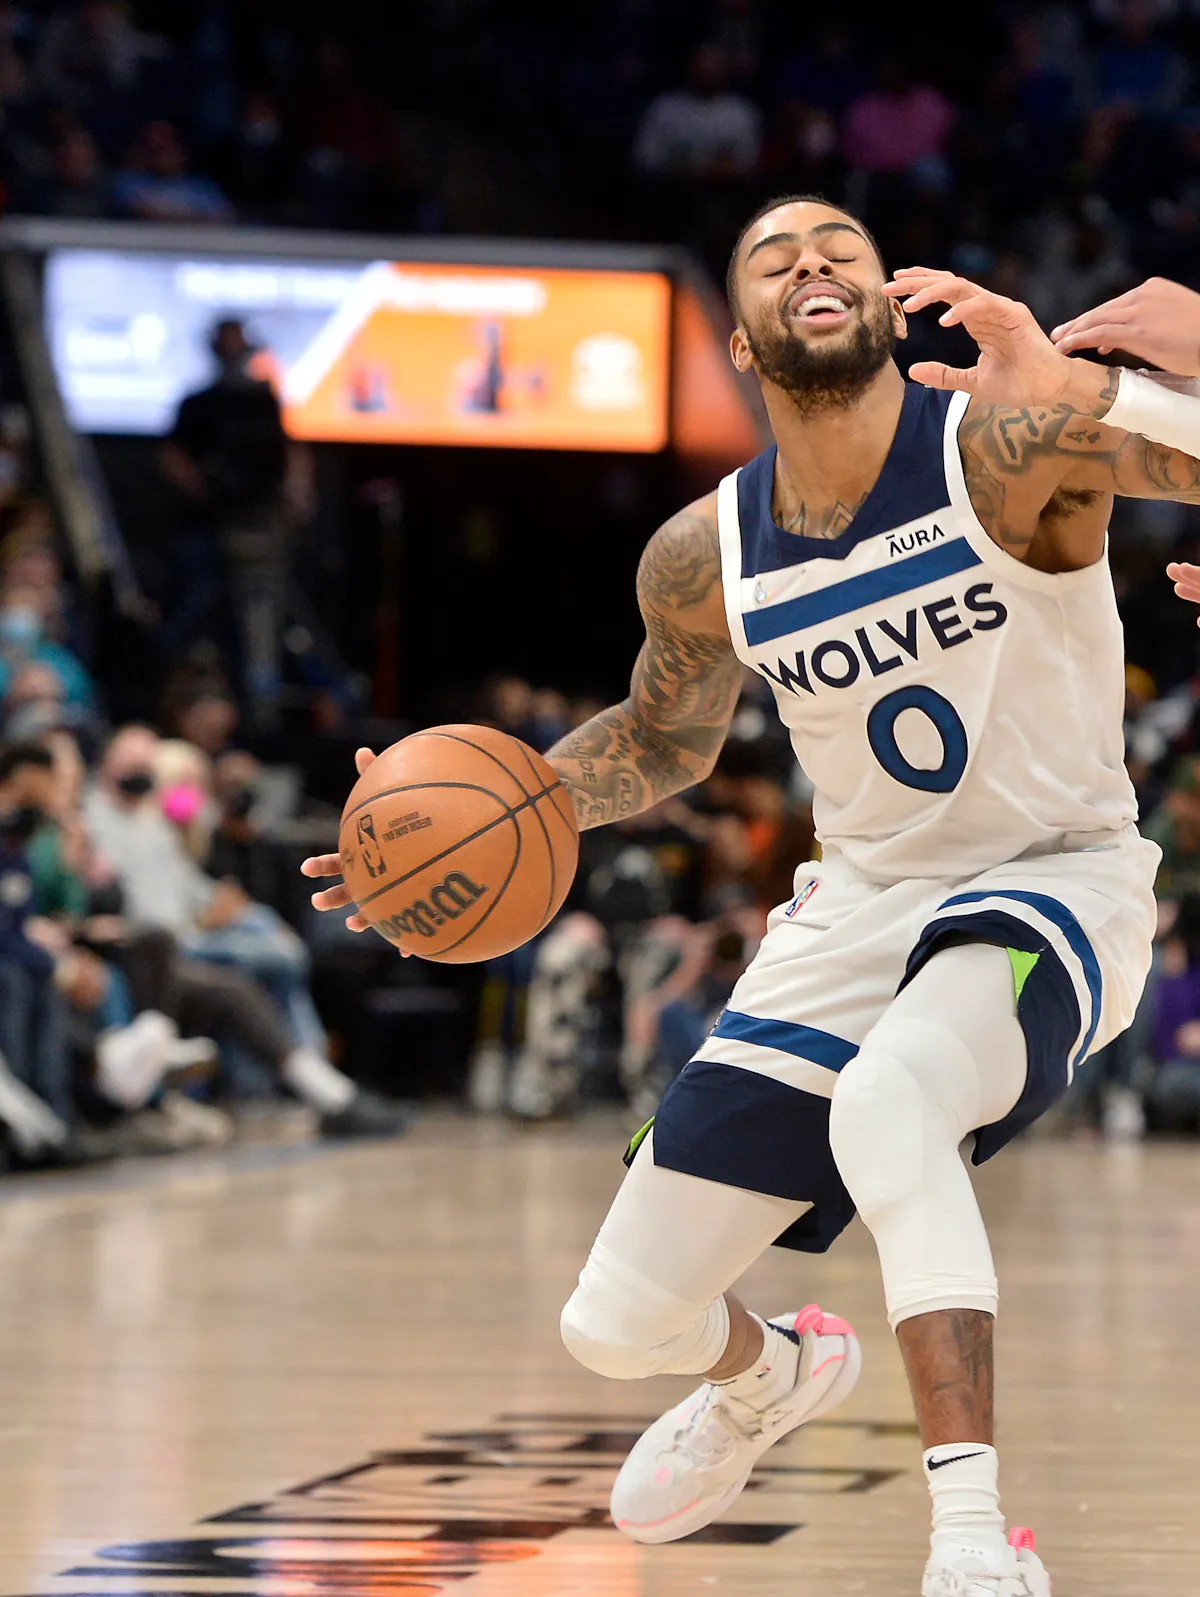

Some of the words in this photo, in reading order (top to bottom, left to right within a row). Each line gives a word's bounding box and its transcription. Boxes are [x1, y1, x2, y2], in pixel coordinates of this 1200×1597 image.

[757, 583, 1008, 697] WOLVES
[866, 685, 969, 793] 0
[380, 870, 488, 938] Wilso
